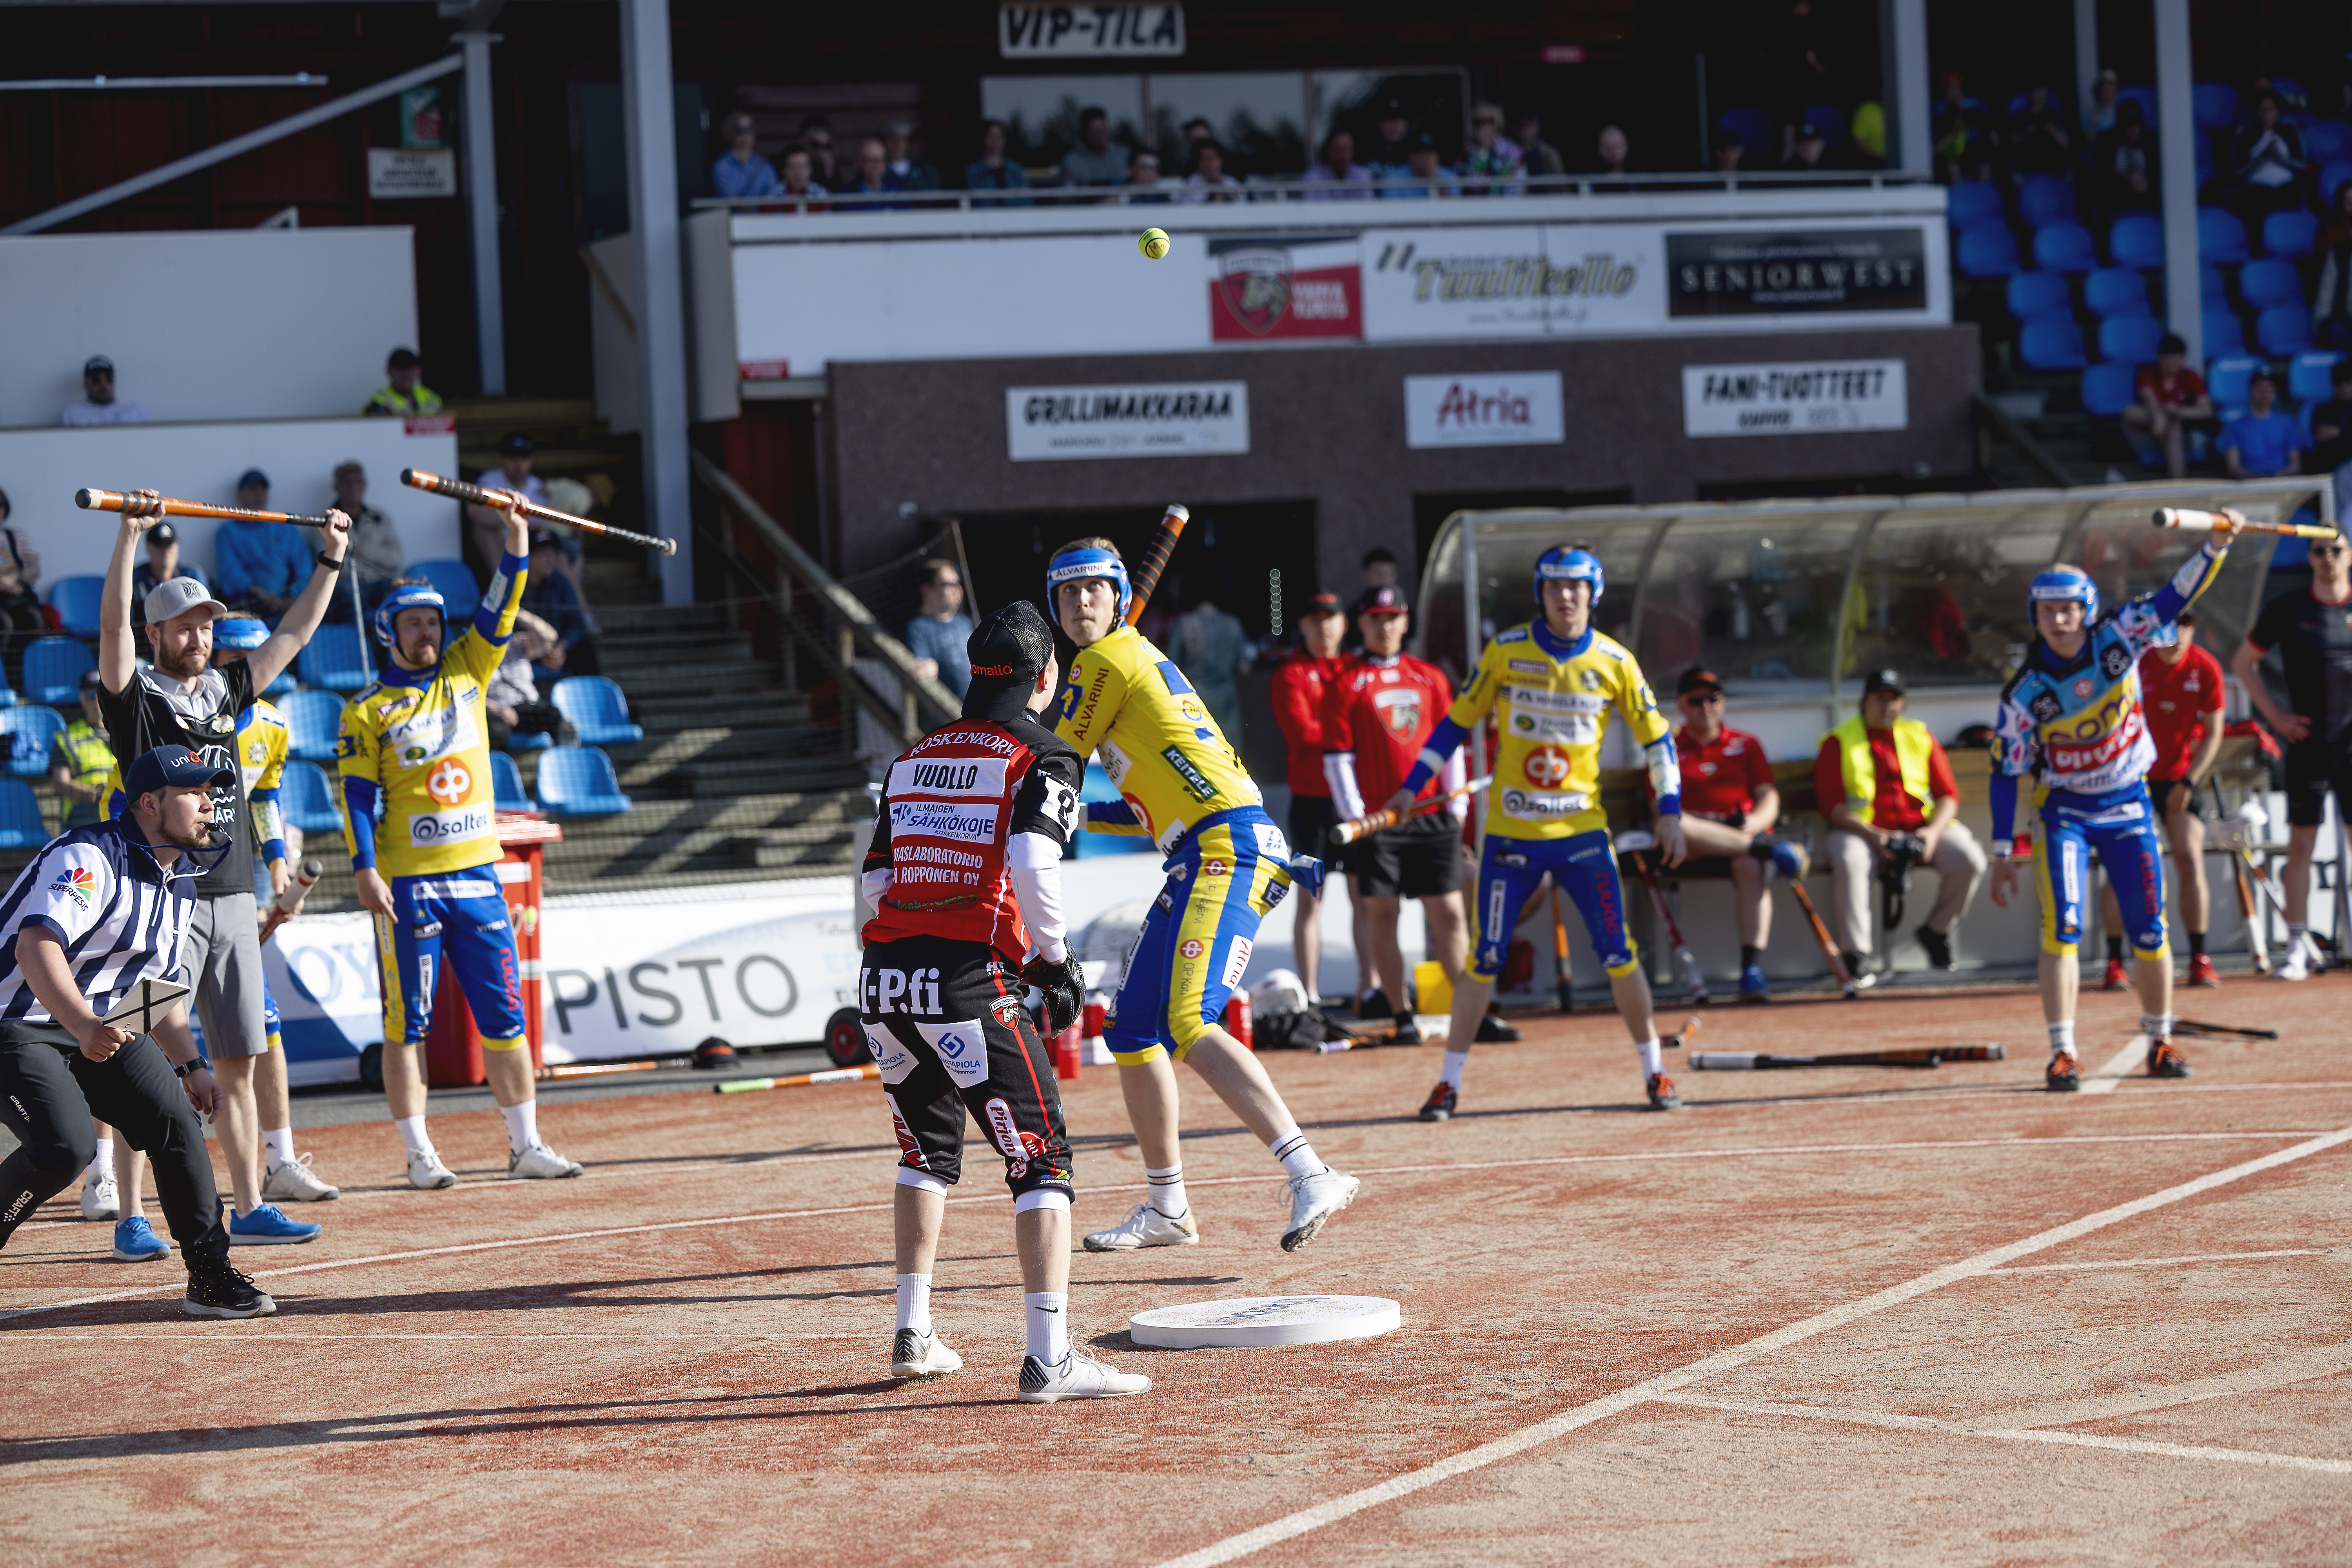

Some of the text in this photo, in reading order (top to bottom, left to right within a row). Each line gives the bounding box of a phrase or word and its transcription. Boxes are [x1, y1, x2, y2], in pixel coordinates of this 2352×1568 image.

[1007, 7, 1176, 47] VIP-TILA
[1681, 258, 1913, 292] SENIORWEST
[1702, 368, 1885, 408] FANI-TUOTTEET
[1025, 393, 1232, 426] GRILLIMAKKARAA
[1436, 383, 1533, 428] Atria
[1056, 564, 1103, 577] ALVARIINI
[970, 662, 1013, 676] omallo
[1073, 668, 1110, 741] ALVARIINI
[912, 764, 978, 790] VUOLLO
[1166, 749, 1214, 797] KEITELE
[915, 803, 955, 815] ILMAJOEN
[907, 813, 995, 837] SÄHKÖKOJE
[934, 829, 977, 840] KOSKENKORVA
[900, 866, 960, 883] ROPPONEN
[963, 872, 980, 886] OY
[48, 883, 89, 912] SUPERPESIS
[1183, 963, 1194, 976] OP
[1229, 940, 1249, 985] Atria
[546, 955, 797, 1034] PISTO
[877, 1052, 906, 1066] TAPIOLA
[10, 1095, 27, 1116] CRAFT
[989, 1106, 1016, 1154] Pirjon
[8, 1190, 33, 1217] CRAFT
